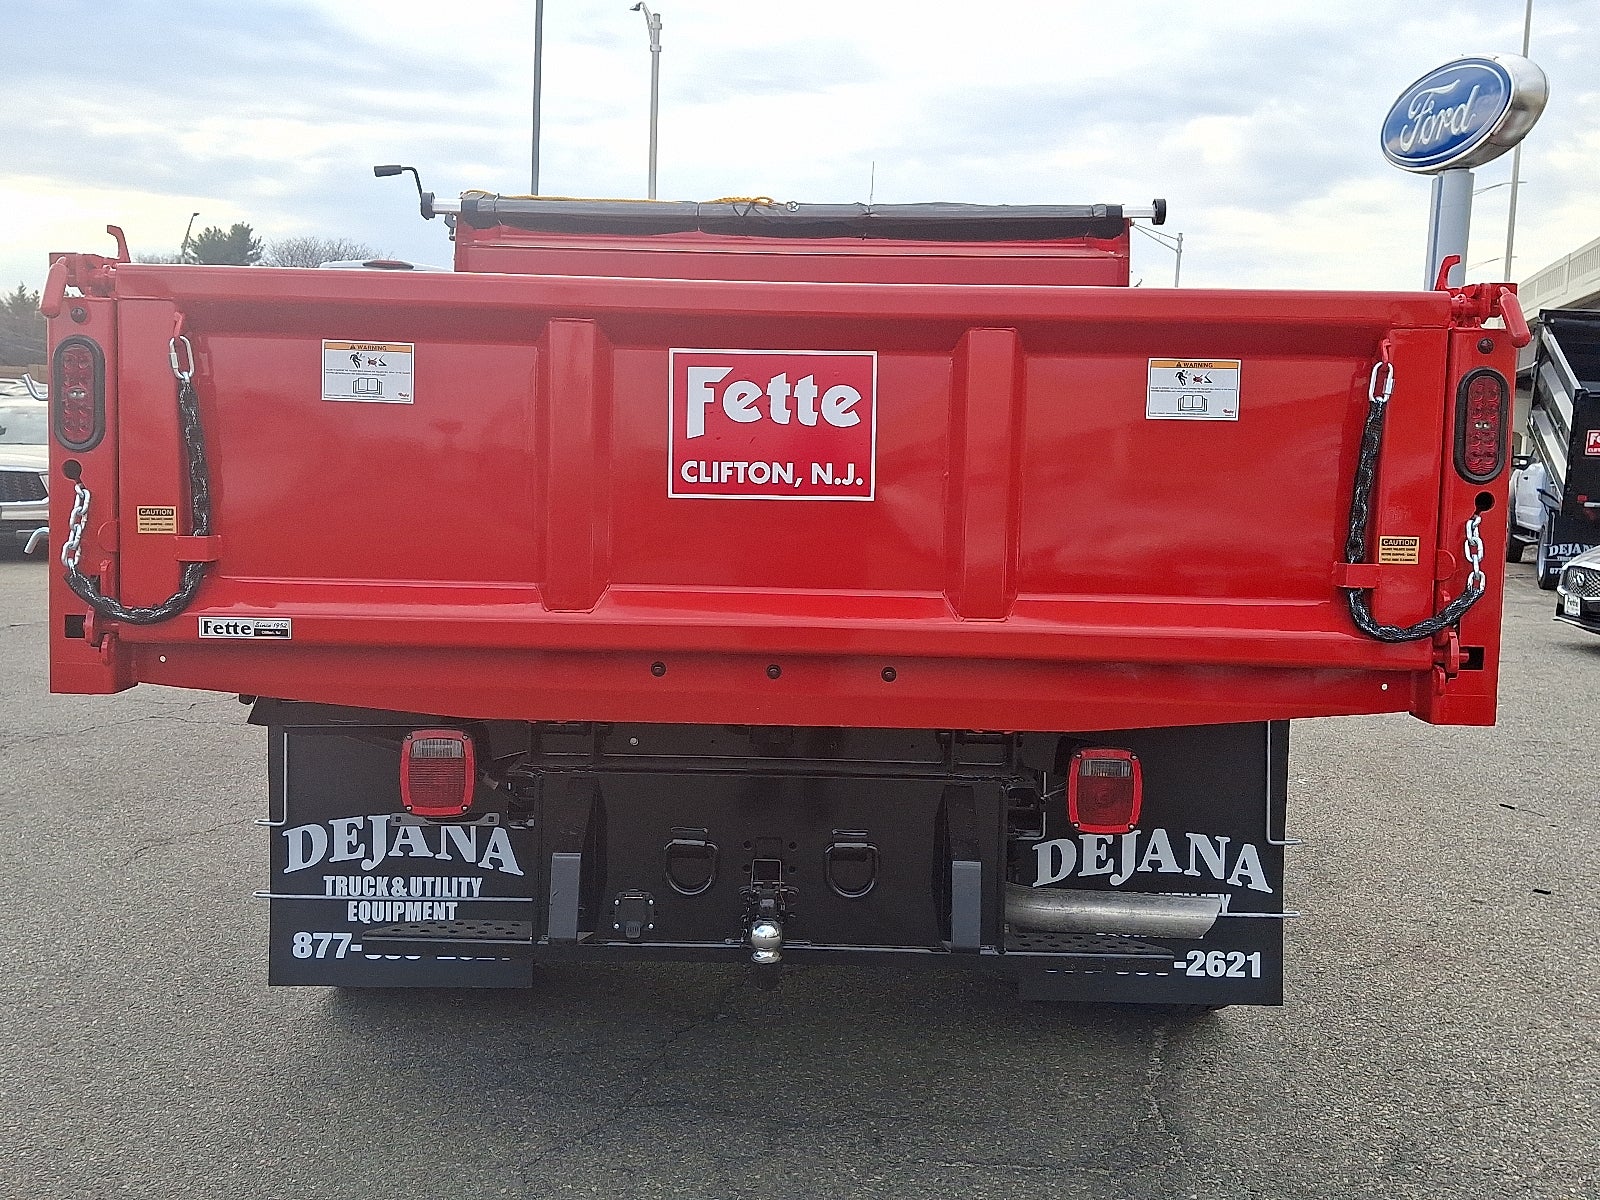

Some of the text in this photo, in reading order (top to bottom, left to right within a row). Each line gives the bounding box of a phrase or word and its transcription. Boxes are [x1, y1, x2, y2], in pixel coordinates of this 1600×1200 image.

[1400, 79, 1480, 152] Ford
[686, 366, 862, 439] Fette
[680, 460, 864, 488] CLIFTON, N.J.
[203, 620, 252, 635] Fette
[282, 814, 525, 876] DEJANA
[1032, 828, 1274, 894] DEJANA
[347, 901, 458, 924] EQUIPMENT
